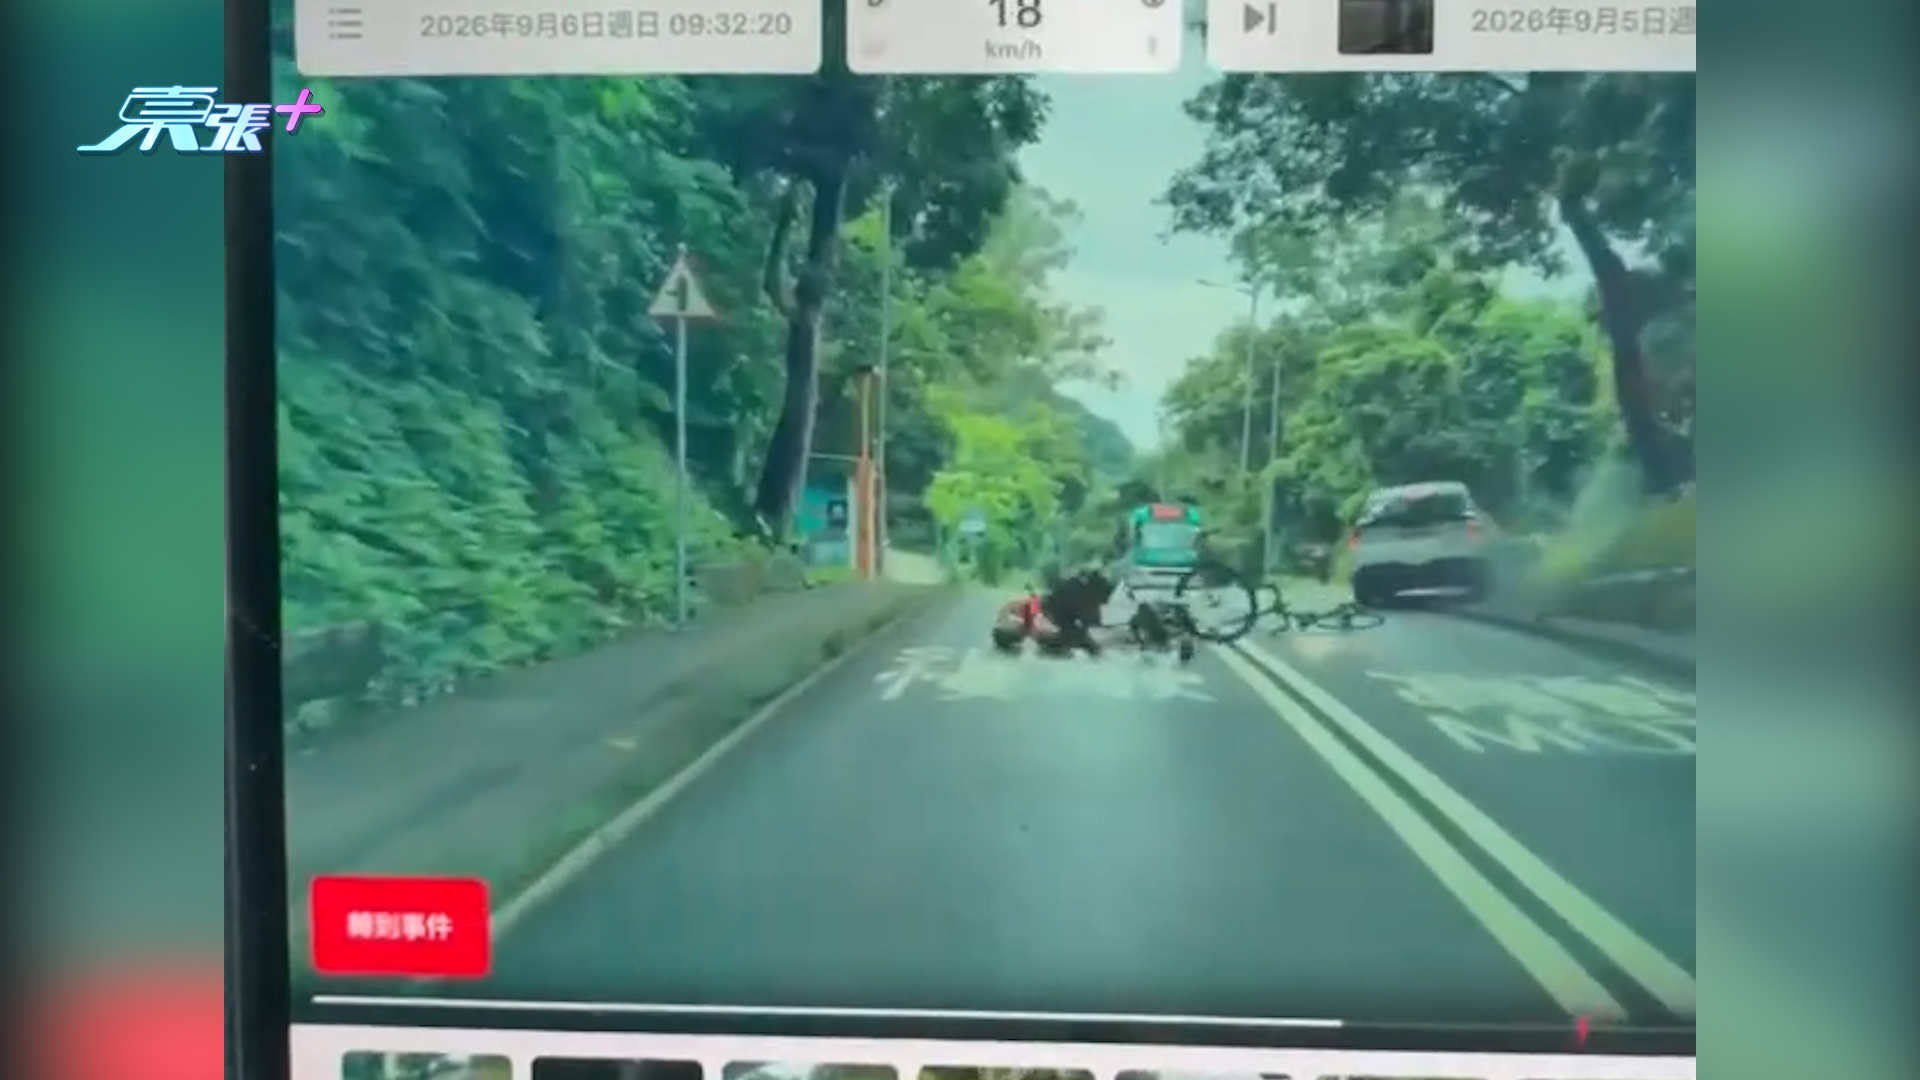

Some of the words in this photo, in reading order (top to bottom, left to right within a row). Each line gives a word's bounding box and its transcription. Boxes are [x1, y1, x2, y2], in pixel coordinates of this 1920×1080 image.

[420, 11, 658, 38] 2026年9月6日週日
[669, 12, 792, 36] 09:32:20
[989, 0, 1042, 27] 18
[985, 38, 1042, 59] km/h
